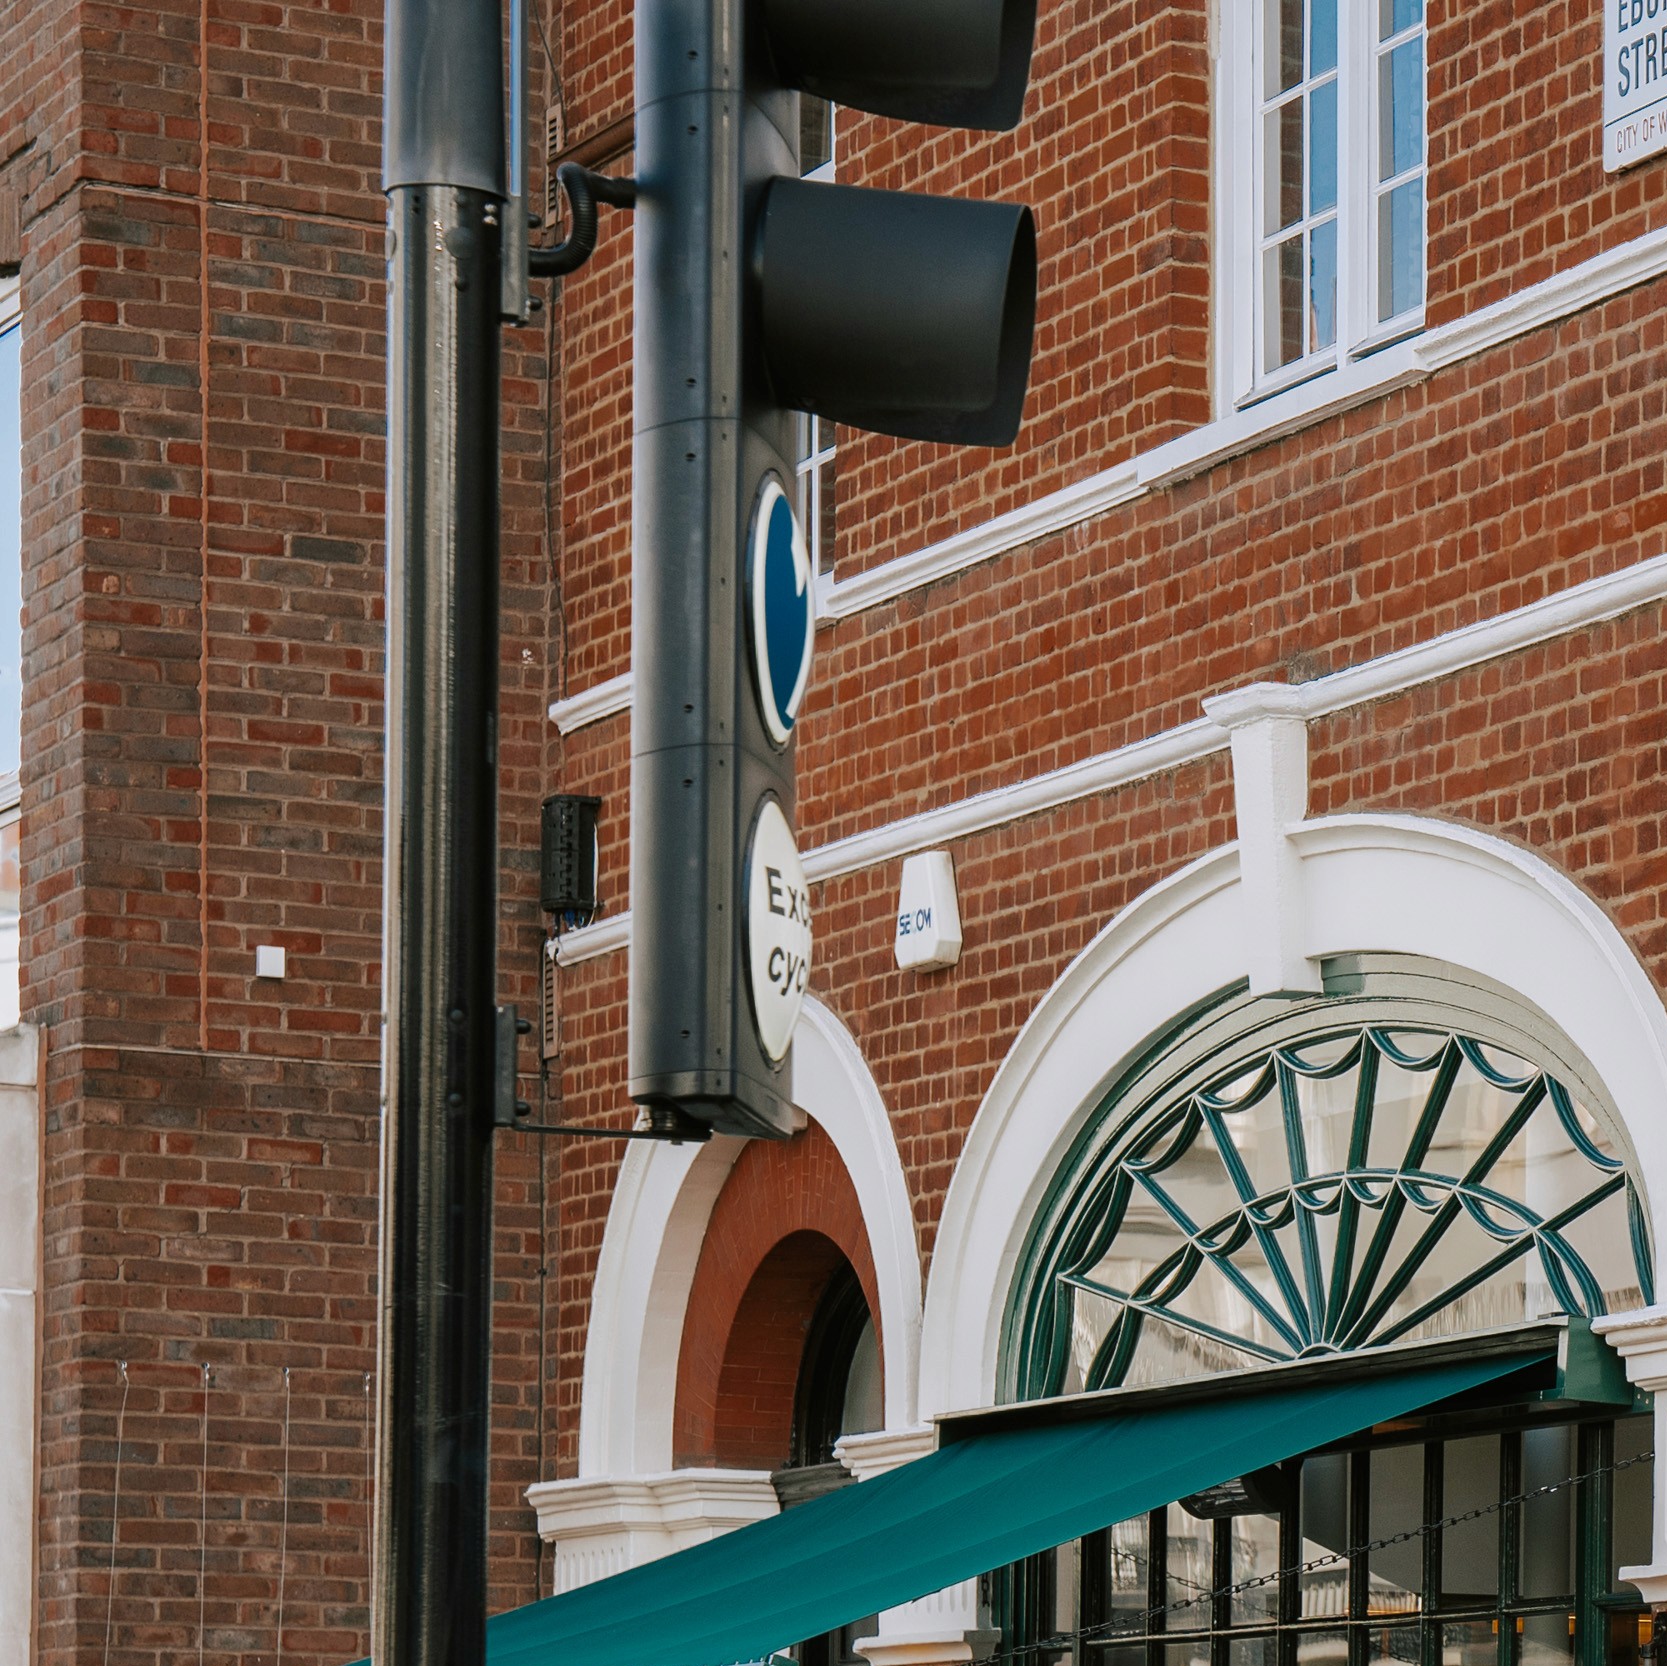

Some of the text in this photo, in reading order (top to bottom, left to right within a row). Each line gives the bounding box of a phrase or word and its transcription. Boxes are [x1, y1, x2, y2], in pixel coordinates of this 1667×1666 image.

[1616, 123, 1638, 154] CITY
[1642, 116, 1655, 142] OF
[765, 865, 812, 928] Exc
